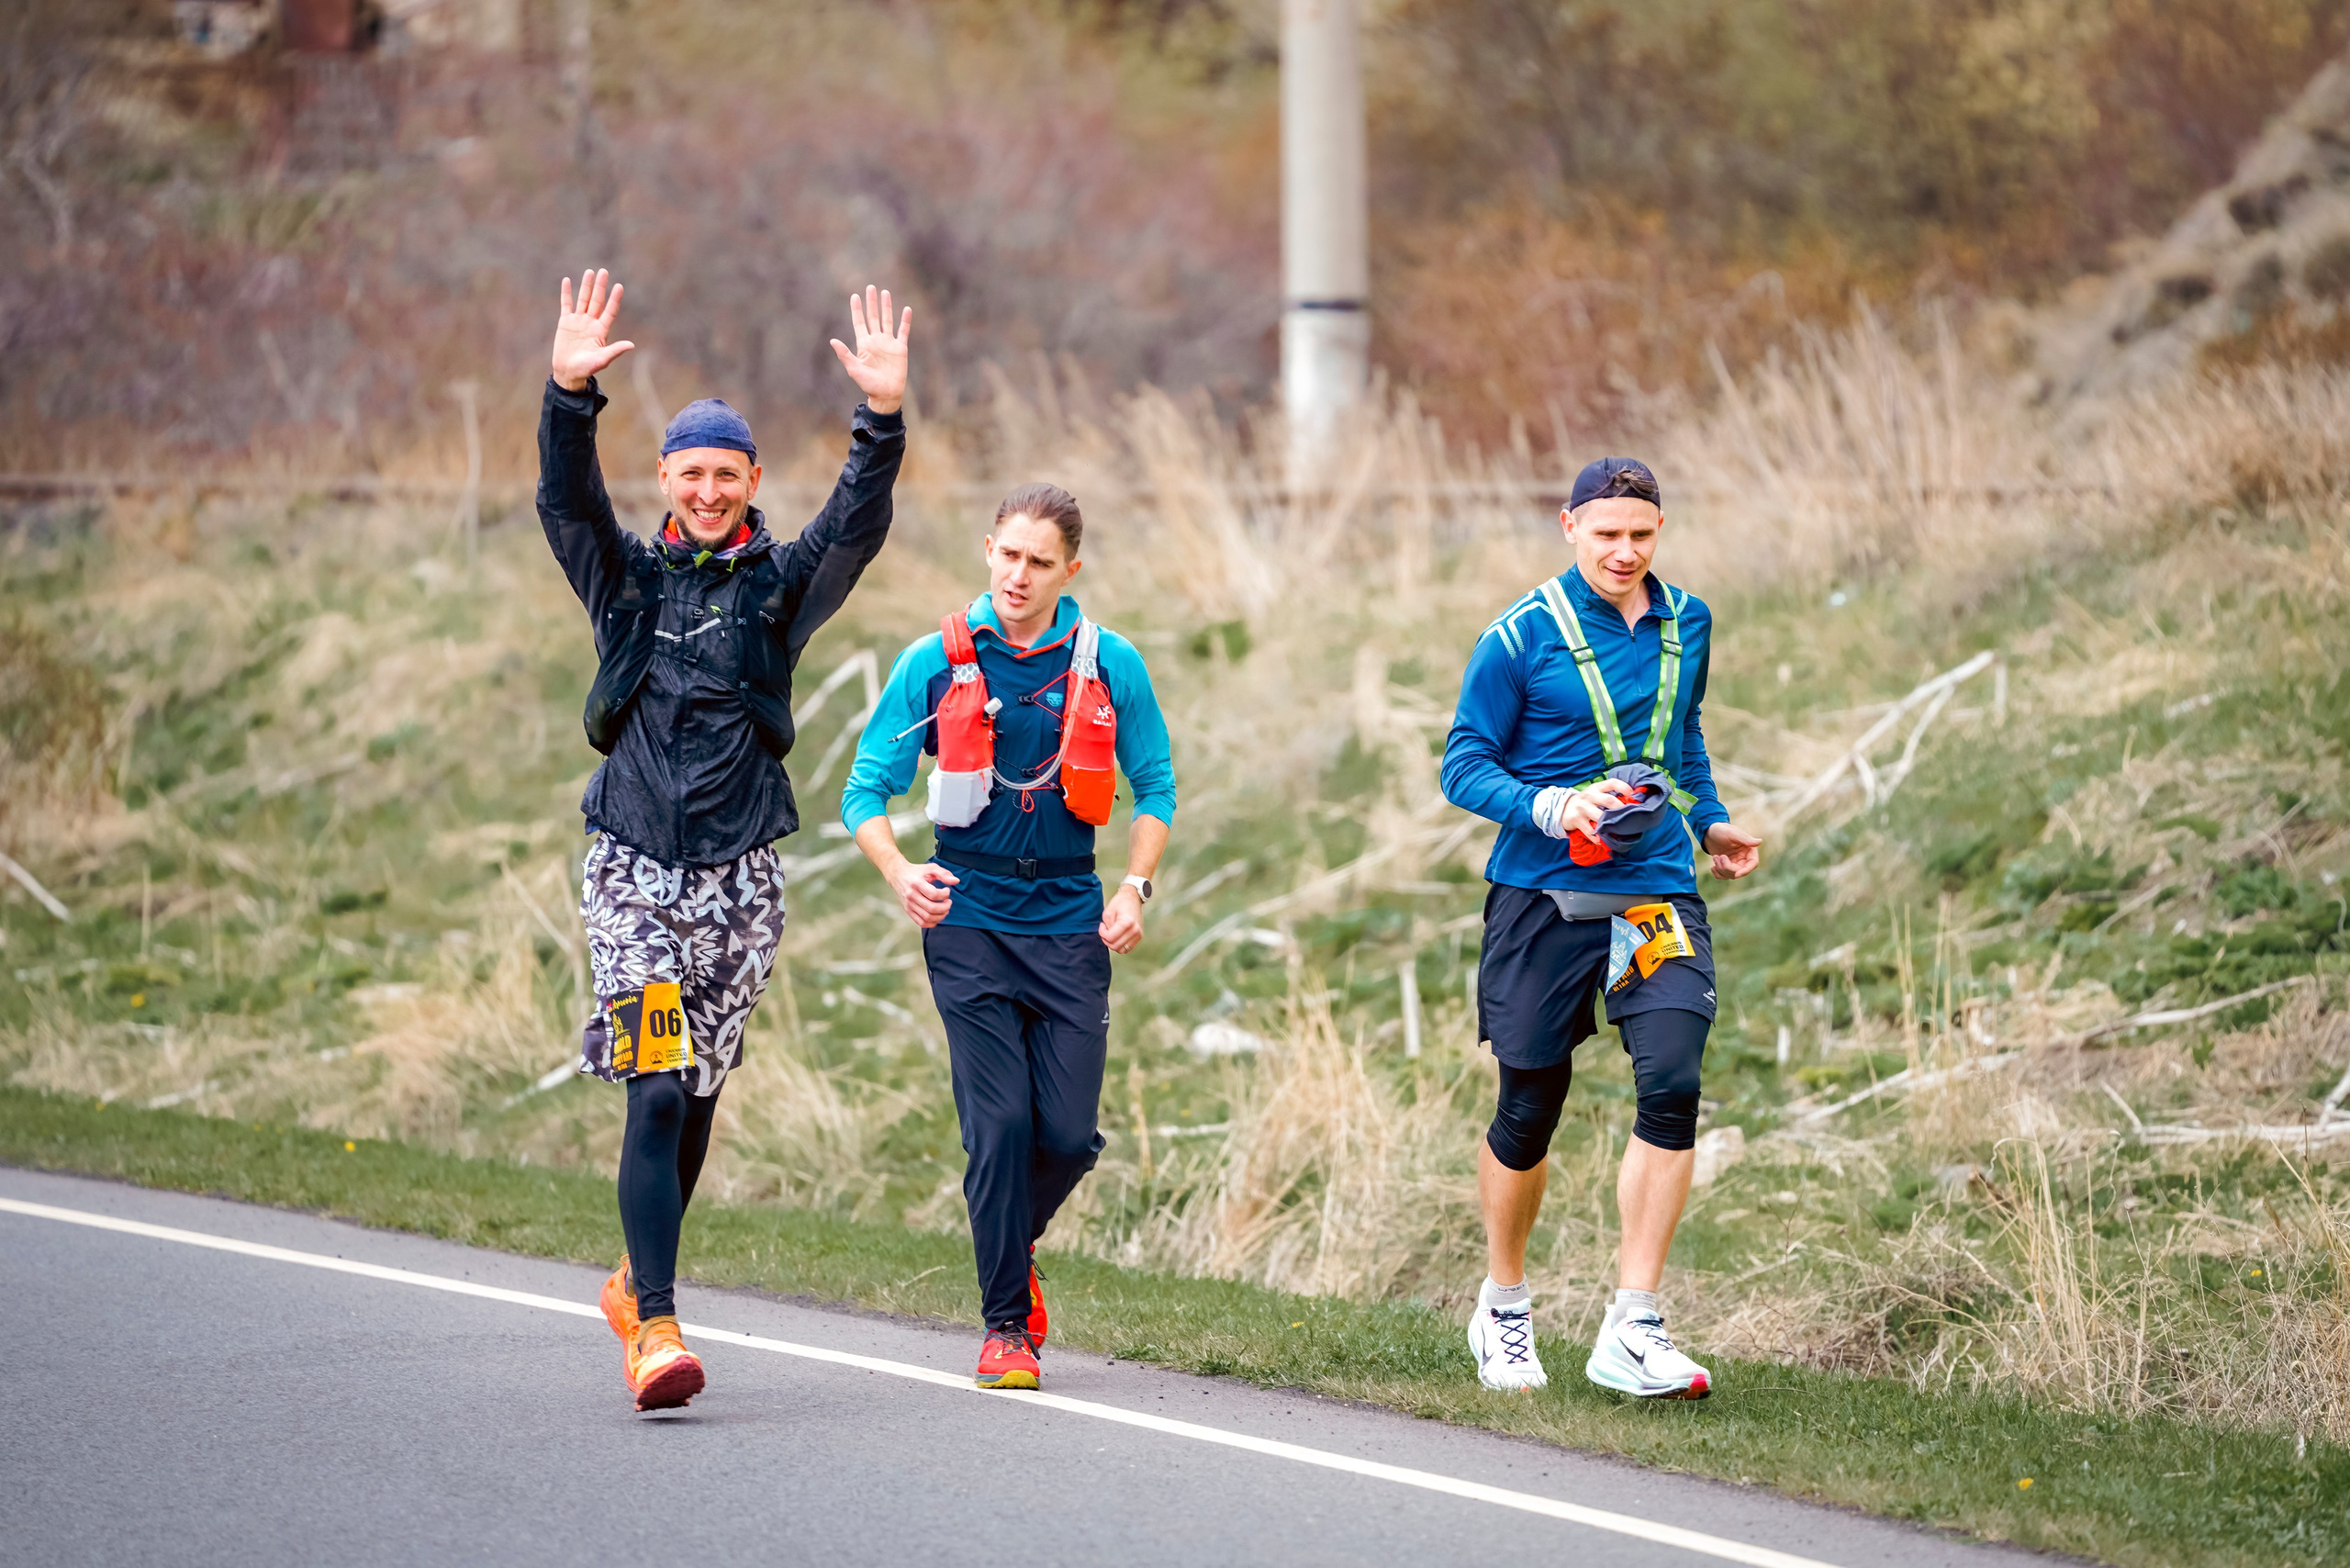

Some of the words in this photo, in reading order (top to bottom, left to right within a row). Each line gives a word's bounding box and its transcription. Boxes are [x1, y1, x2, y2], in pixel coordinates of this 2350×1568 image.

[1637, 913, 1673, 943] 04
[1662, 945, 1684, 953] UNITED
[649, 1008, 681, 1038] 06
